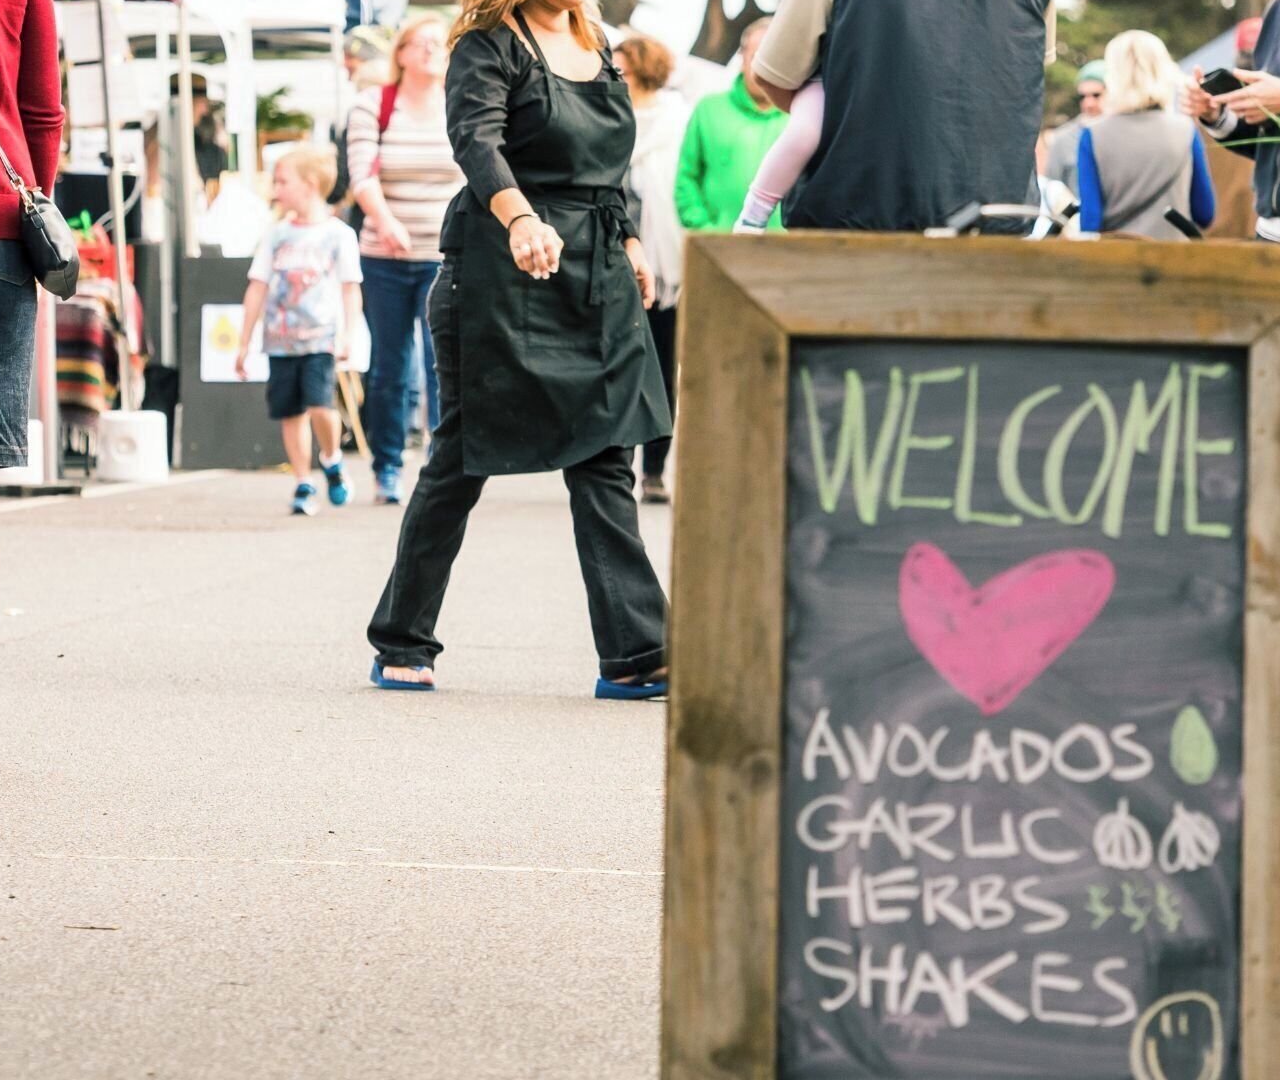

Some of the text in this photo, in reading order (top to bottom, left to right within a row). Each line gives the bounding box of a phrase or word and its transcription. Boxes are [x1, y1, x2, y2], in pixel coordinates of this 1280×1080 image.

[799, 362, 1234, 537] WELCOME
[802, 707, 1153, 783] AVOCADOS
[796, 795, 1081, 864] GARLIC
[806, 866, 1070, 934] HERBS
[803, 937, 1138, 1028] SHAKES
